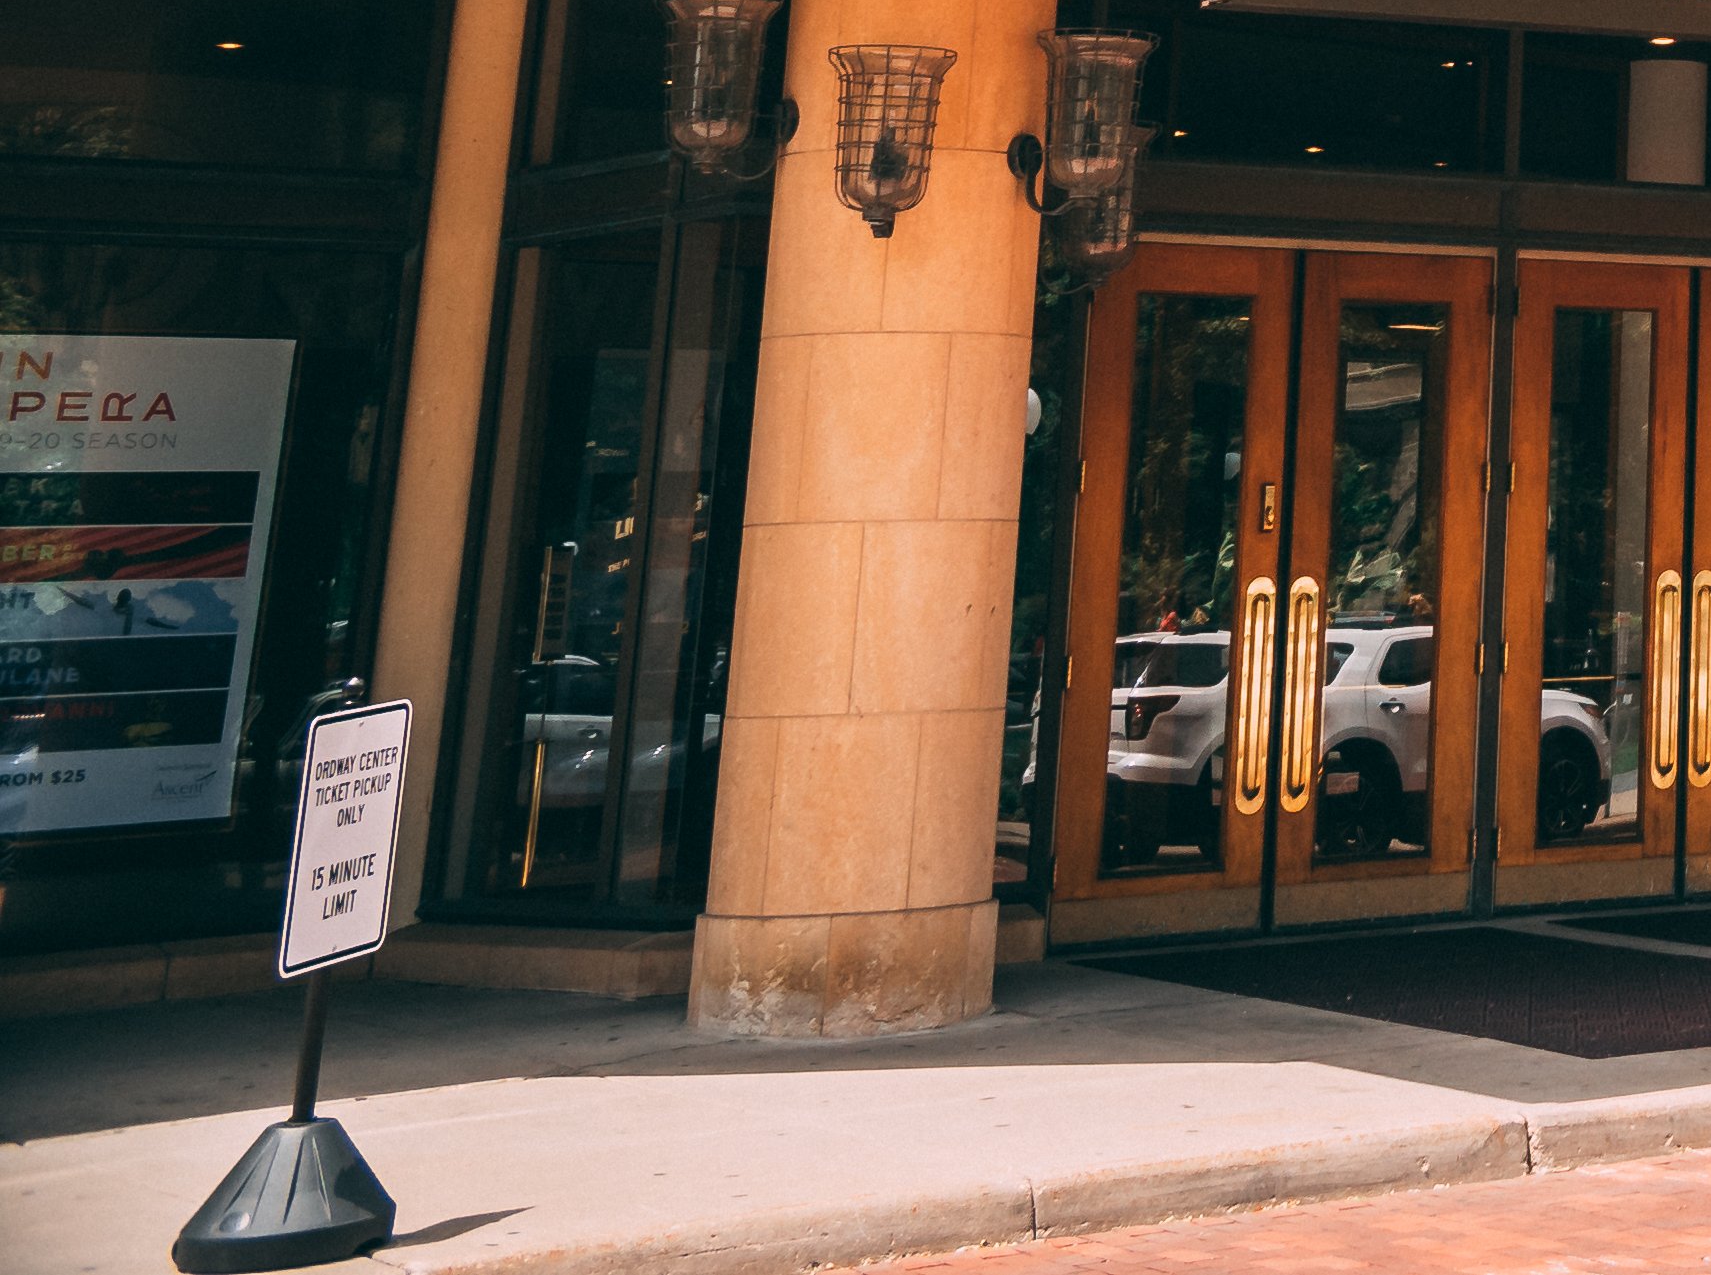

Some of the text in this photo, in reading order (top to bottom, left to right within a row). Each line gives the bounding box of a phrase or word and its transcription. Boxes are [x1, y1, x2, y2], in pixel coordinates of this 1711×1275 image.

[72, 431, 178, 449] SEASON
[51, 769, 86, 785] $25
[315, 746, 399, 782] ORDWAY CENTER
[315, 772, 392, 807] TICKET PICKUP
[337, 804, 365, 827] ONLY
[311, 853, 377, 891] 15 MINUTE
[322, 889, 358, 920] LIMIT
